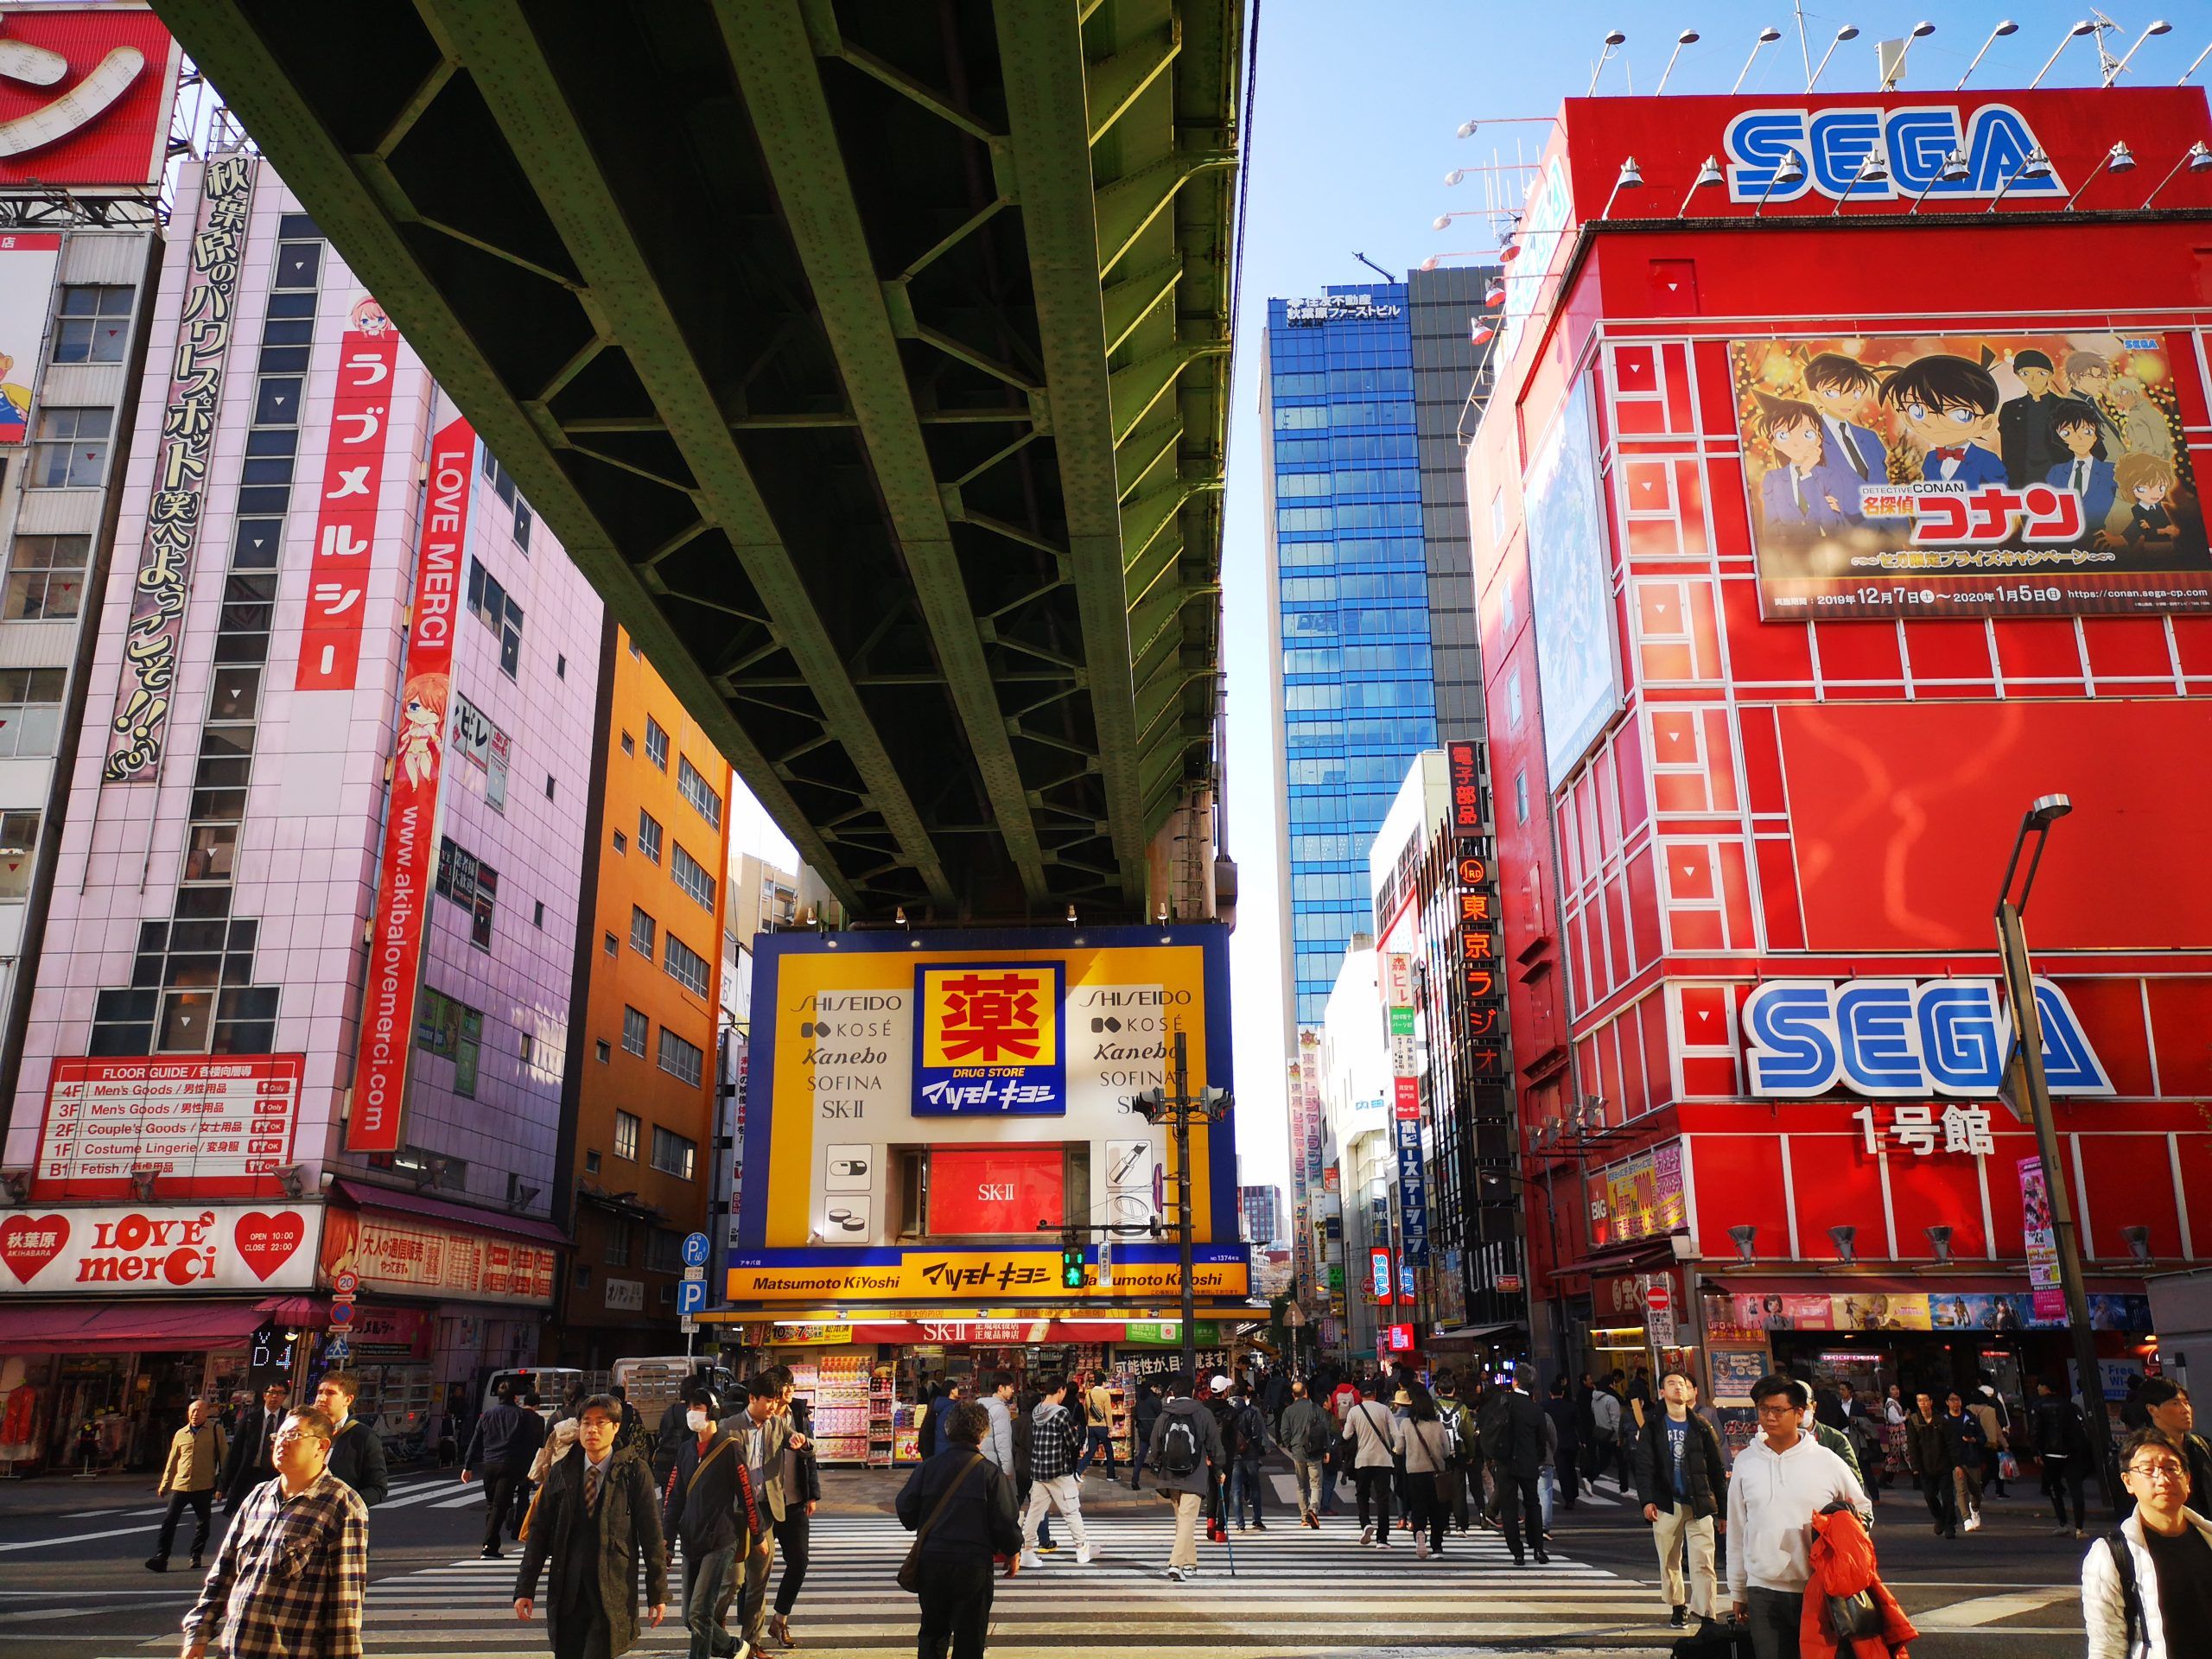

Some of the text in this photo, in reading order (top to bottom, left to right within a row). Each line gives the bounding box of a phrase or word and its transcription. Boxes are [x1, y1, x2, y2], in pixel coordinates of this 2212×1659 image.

[1724, 105, 2069, 202] SEGA
[2, 237, 16, 249] 店
[1287, 305, 1401, 320] 秋葉原ファーストビル
[2125, 340, 2158, 350] SEGA
[1913, 483, 1964, 493] CONAN
[314, 353, 386, 675] ラブメルシー
[1864, 487, 2080, 540] 名探偵 コナン
[417, 452, 465, 646] LOVE MERCI
[2067, 588, 2209, 599] https://conan.sega-cp.com
[365, 805, 419, 1132] www.akibalovemerci.com
[1461, 895, 1497, 1074] 東京ラジオ
[791, 995, 902, 1013] SHISEIDO
[1079, 989, 1192, 1007] SHISEIDO
[941, 973, 1041, 1062] 薬
[1128, 1014, 1182, 1032] KOSÉ
[836, 1020, 892, 1037] KOSÉ
[1744, 980, 2116, 1097] SEGA
[802, 1047, 887, 1065] Kanebo
[103, 1067, 145, 1079] FLOOR
[149, 1067, 188, 1078] GUIDE
[952, 1067, 1026, 1077] DRUG STORE
[1100, 1071, 1177, 1087] SOFINA
[61, 1085, 82, 1097] 4F
[94, 1085, 130, 1096] Men's
[132, 1085, 173, 1096] Goods
[183, 1083, 226, 1094] 男性用品
[807, 1076, 882, 1091] SOFINA
[922, 1079, 1055, 1110] マツモトキヨシ
[59, 1104, 79, 1116] 3F
[91, 1104, 125, 1115] Men's
[130, 1103, 169, 1115] Goods
[181, 1103, 224, 1114] 男性用品
[267, 1103, 283, 1112] Only
[55, 1124, 76, 1136] 2F
[87, 1123, 142, 1137] Couple's
[146, 1123, 186, 1134] Goods
[199, 1122, 242, 1133] 女士用品
[1853, 1105, 1995, 1155] 1号館
[54, 1144, 72, 1156] 1F
[85, 1143, 142, 1155] Costume
[146, 1142, 197, 1155] Lingerie
[207, 1141, 239, 1153] 変身服
[49, 1163, 69, 1177] B1
[81, 1163, 119, 1174] Fetish
[1591, 1199, 1607, 1220] BIG
[7, 1231, 58, 1249] 秋葉原
[91, 1214, 207, 1251] LOVE
[250, 1231, 294, 1241] OPEN 10:00
[245, 1243, 293, 1252] CLOSE 22:00
[363, 1234, 424, 1262] 大人の通信販売
[688, 1241, 702, 1262] P 60
[380, 1261, 409, 1275] やってます。
[923, 1262, 1051, 1291] マツモトキヨシ
[1373, 1254, 1389, 1297] SEGA
[340, 1277, 353, 1288] 20
[753, 1275, 900, 1291] Matsumoto KiYoshi
[1166, 1273, 1223, 1286] Kioshi
[684, 1284, 702, 1312] P
[975, 1331, 1020, 1340] 正規品牌店
[2108, 1364, 2134, 1376] Free
